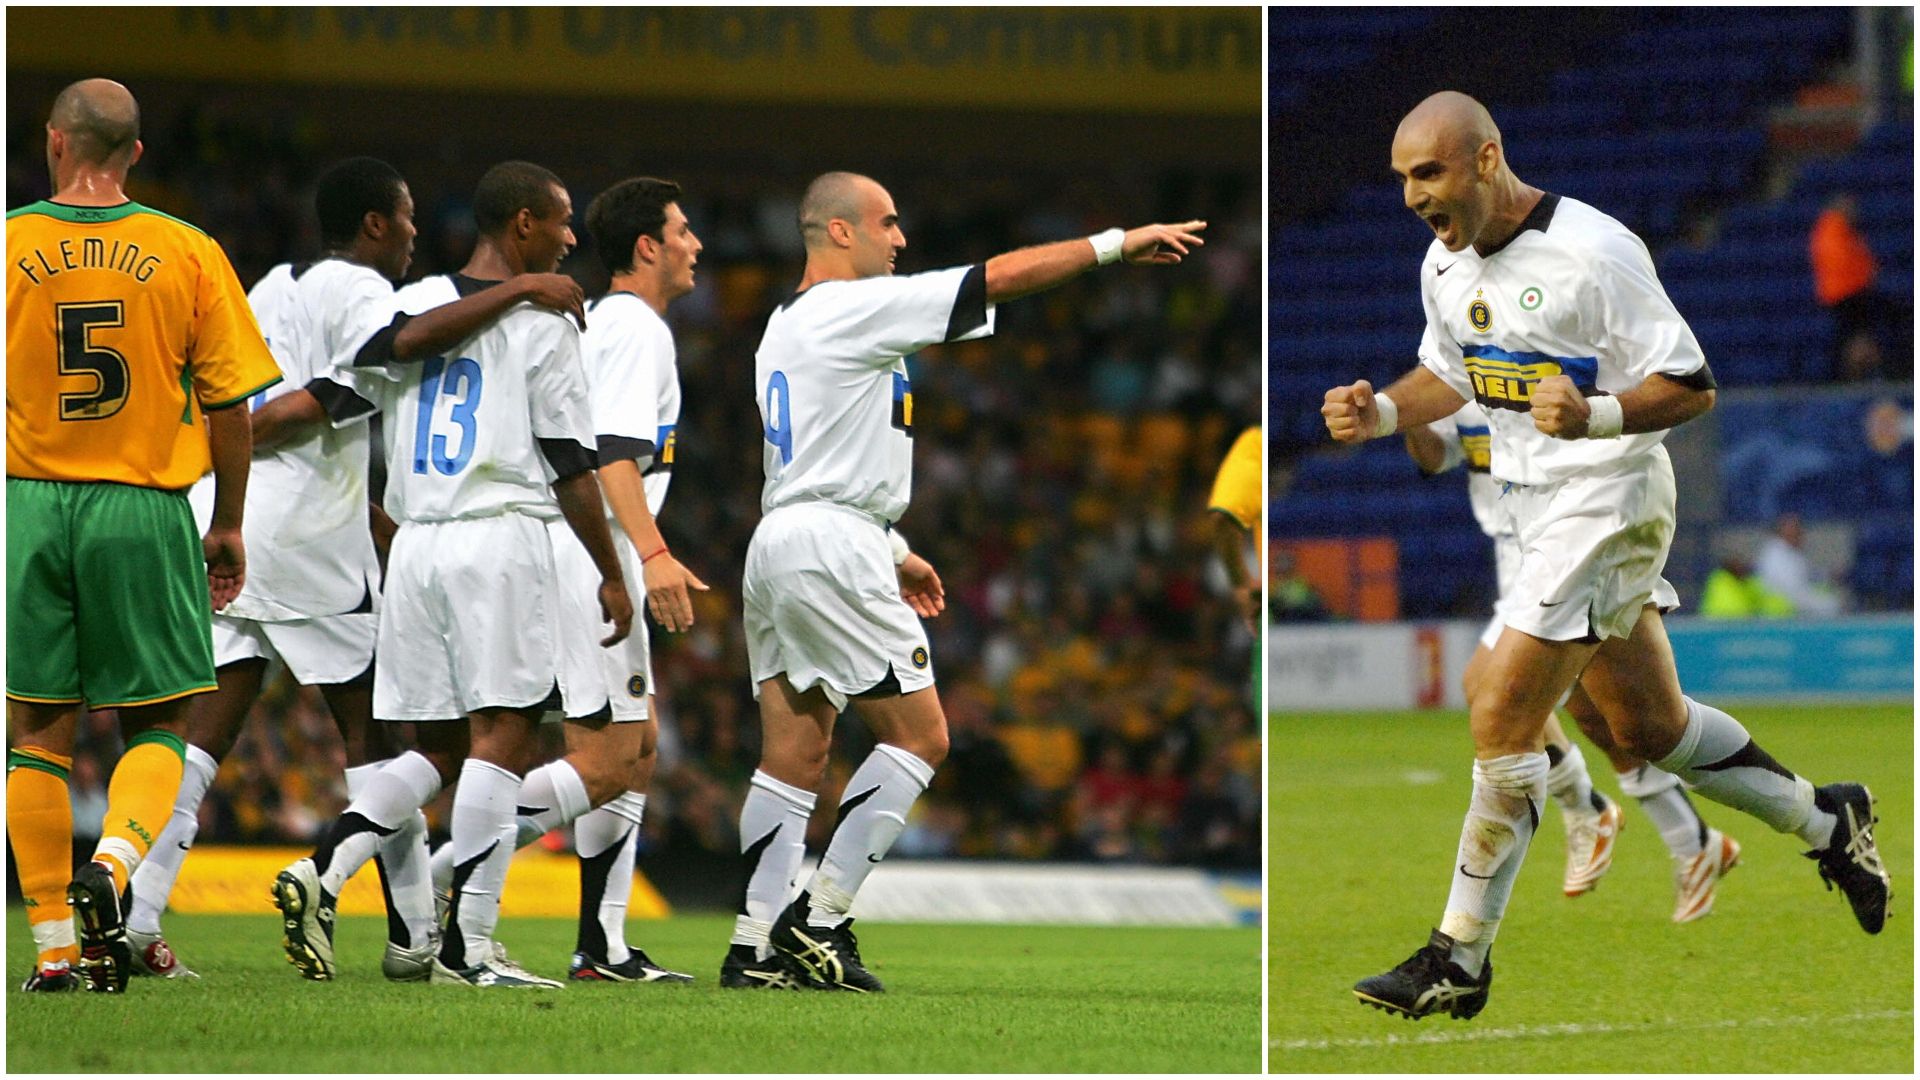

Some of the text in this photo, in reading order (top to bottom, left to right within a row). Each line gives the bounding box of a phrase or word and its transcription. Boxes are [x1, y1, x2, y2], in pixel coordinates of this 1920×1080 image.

[17, 237, 162, 285] FLEMING
[55, 300, 130, 420] 5
[413, 357, 482, 476] 13
[765, 370, 793, 466] 9
